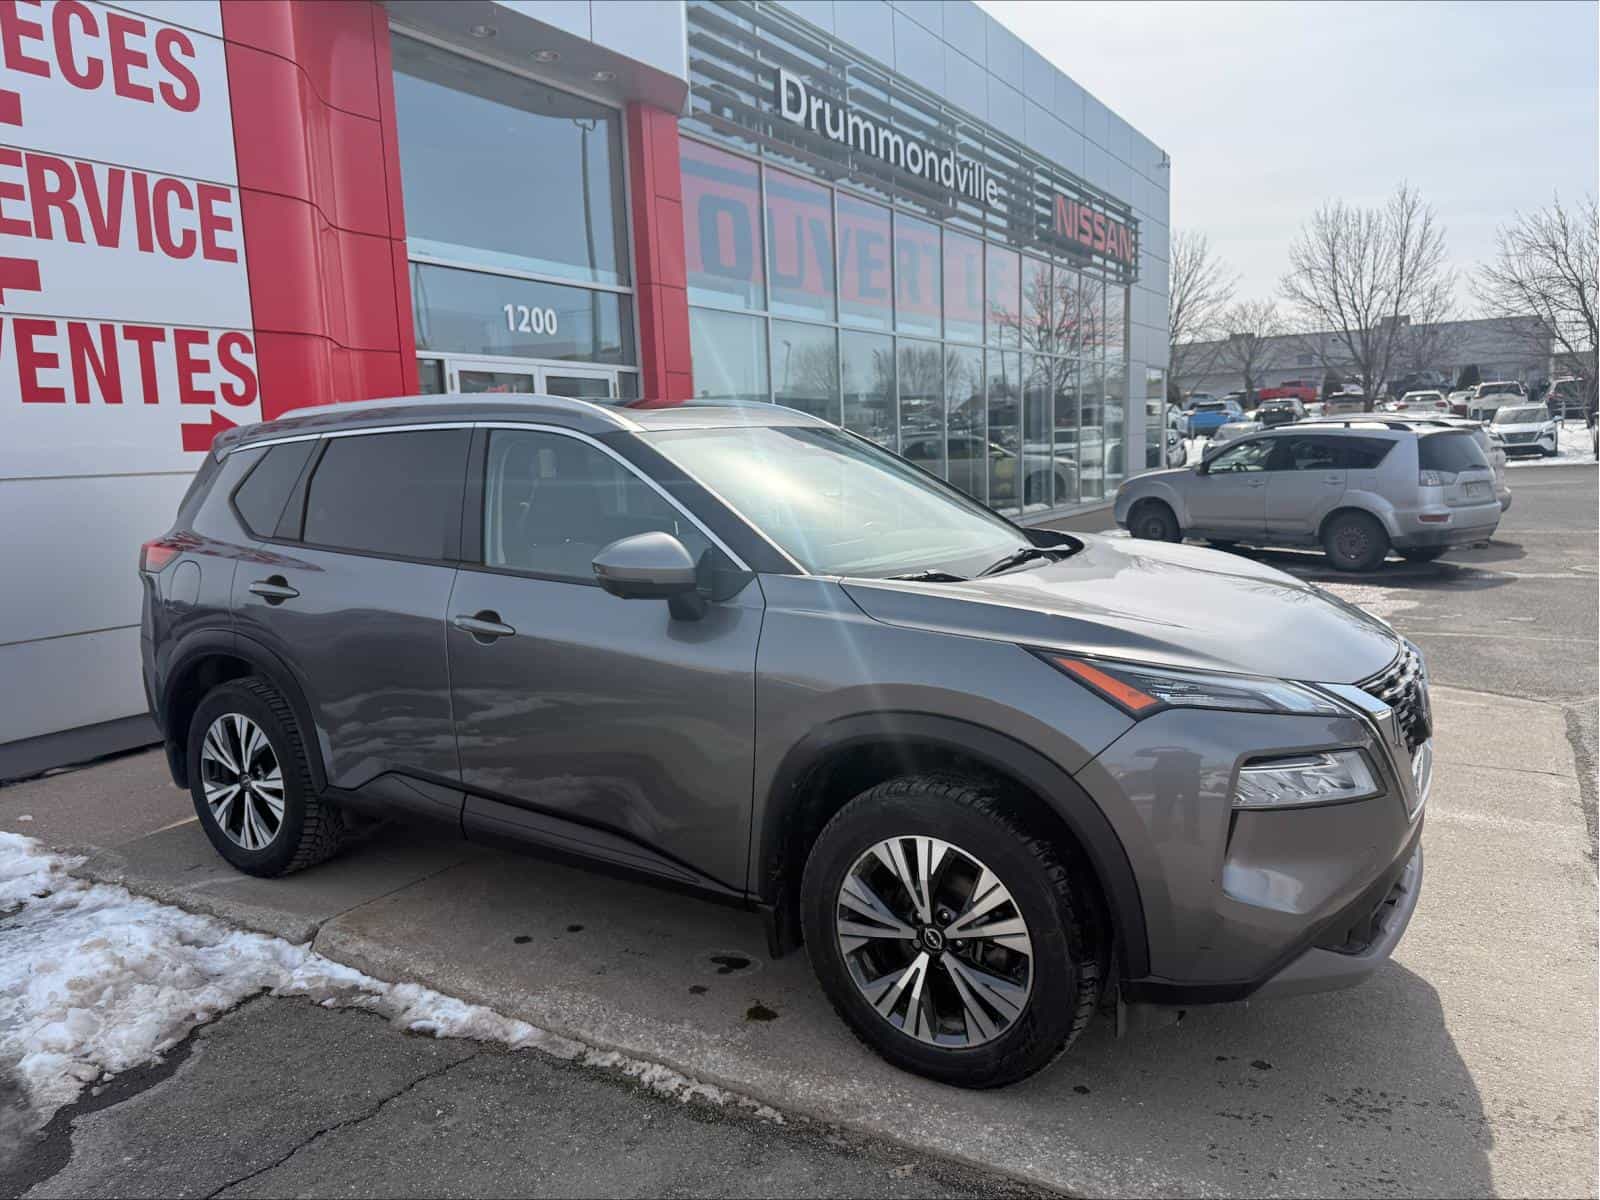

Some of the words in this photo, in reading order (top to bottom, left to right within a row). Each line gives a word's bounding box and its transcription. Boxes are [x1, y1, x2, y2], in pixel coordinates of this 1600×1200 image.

[780, 67, 999, 204] Drummondville
[1055, 194, 1132, 263] NISSAN
[504, 303, 558, 336] 1200
[0, 317, 258, 406] ENTES
